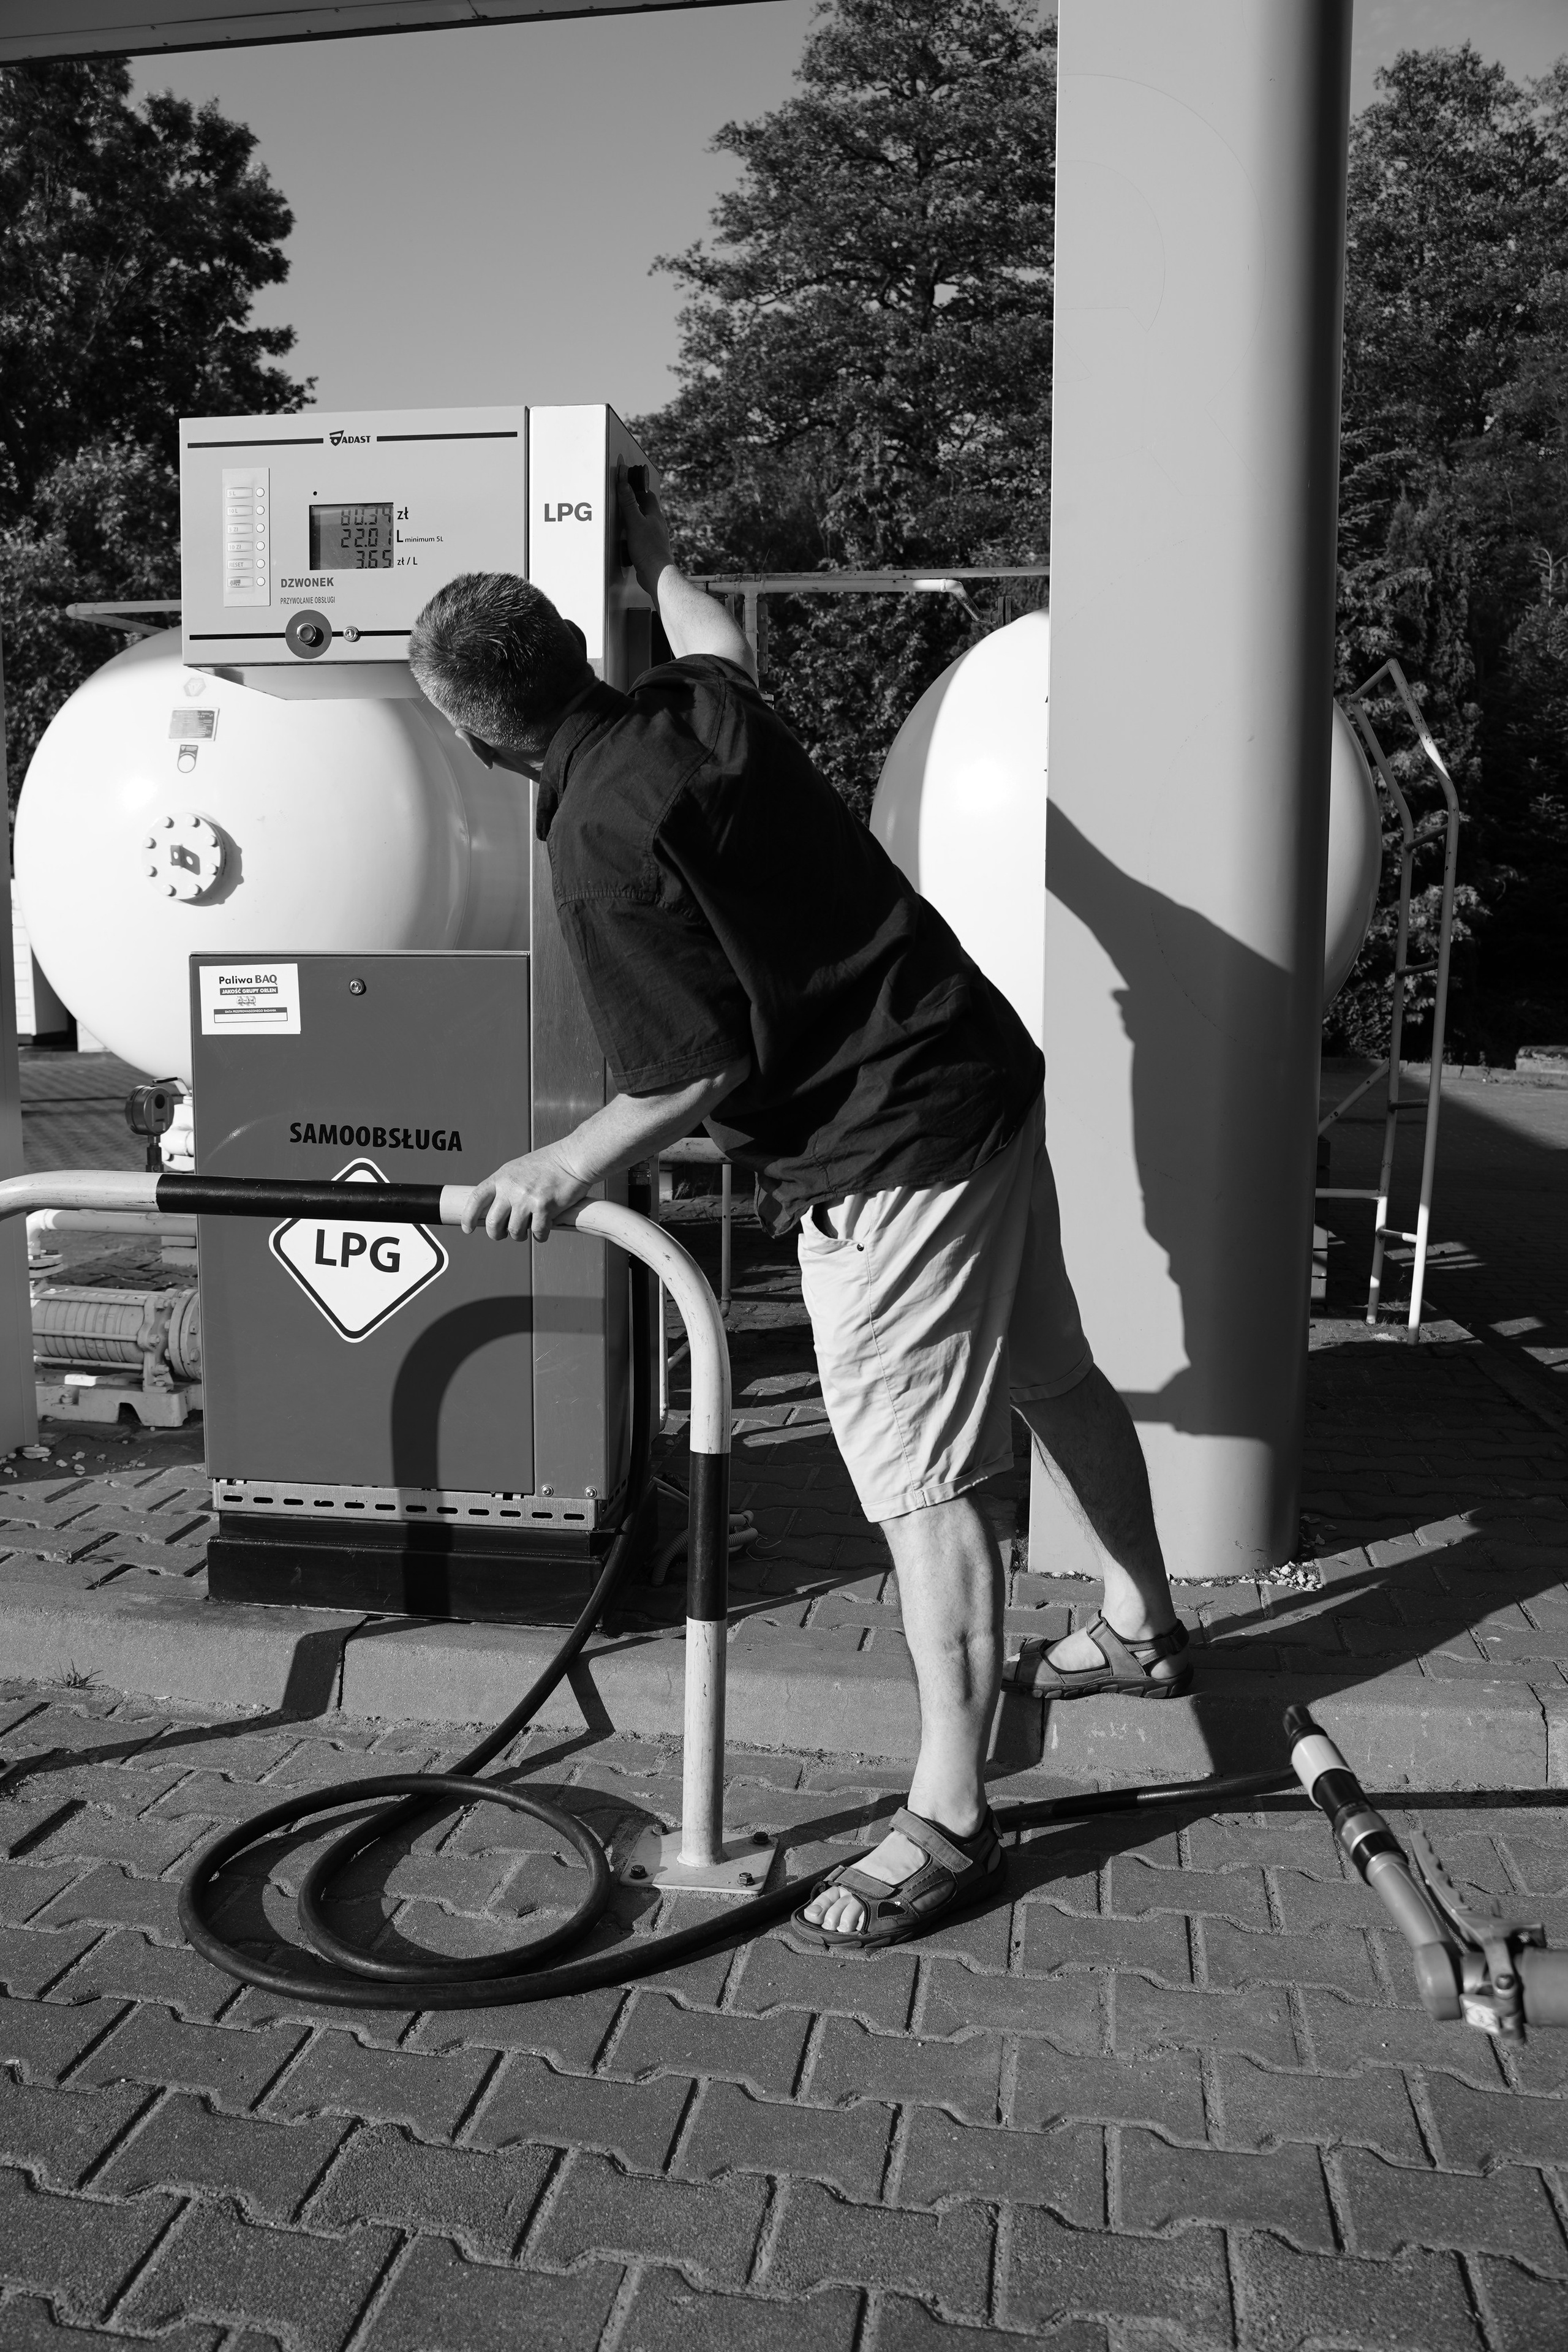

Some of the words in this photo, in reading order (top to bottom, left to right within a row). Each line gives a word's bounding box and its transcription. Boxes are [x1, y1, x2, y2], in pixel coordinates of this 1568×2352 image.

[397, 507, 409, 520] zł
[544, 502, 592, 522] LPG
[341, 528, 392, 548] 22.01
[397, 529, 404, 543] L
[355, 549, 392, 569] 3.65
[397, 557, 404, 565] zł
[413, 557, 418, 565] L
[281, 577, 334, 588] DZWONEK
[219, 976, 253, 984] Paliwa
[255, 974, 277, 986] BAQ
[290, 1122, 462, 1152] SAMOOBSŁUGA
[315, 1229, 401, 1273] LPG
